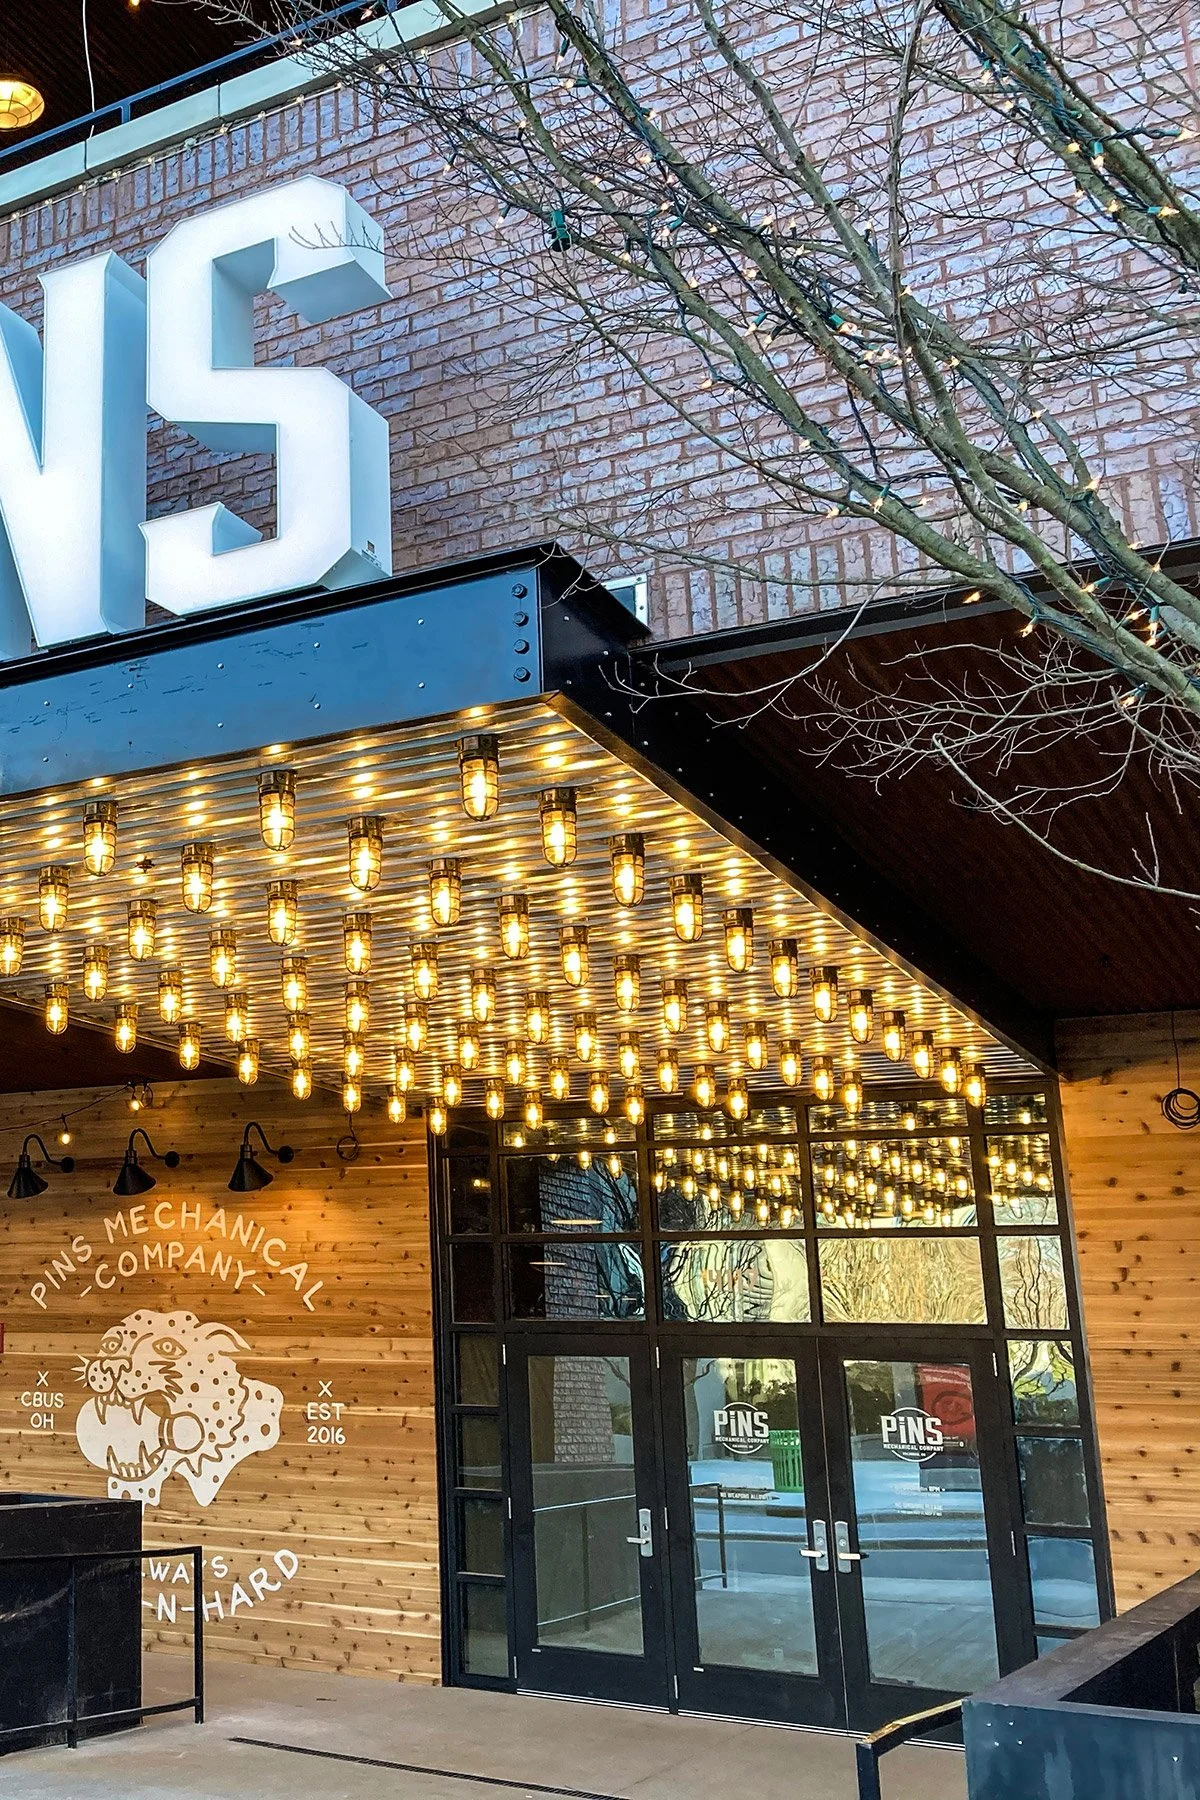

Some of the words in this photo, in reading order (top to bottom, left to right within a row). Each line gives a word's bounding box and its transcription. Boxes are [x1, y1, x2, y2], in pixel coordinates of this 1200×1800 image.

[30, 1235, 92, 1310] PINS
[103, 1201, 323, 1312] MECHANICAL
[21, 1391, 64, 1408] CBUS
[307, 1402, 345, 1421] EST
[30, 1412, 54, 1430] OH
[307, 1425, 347, 1445] 2016
[715, 1436, 746, 1444] MECHANICAL
[883, 1443, 917, 1451] MECHANICAL
